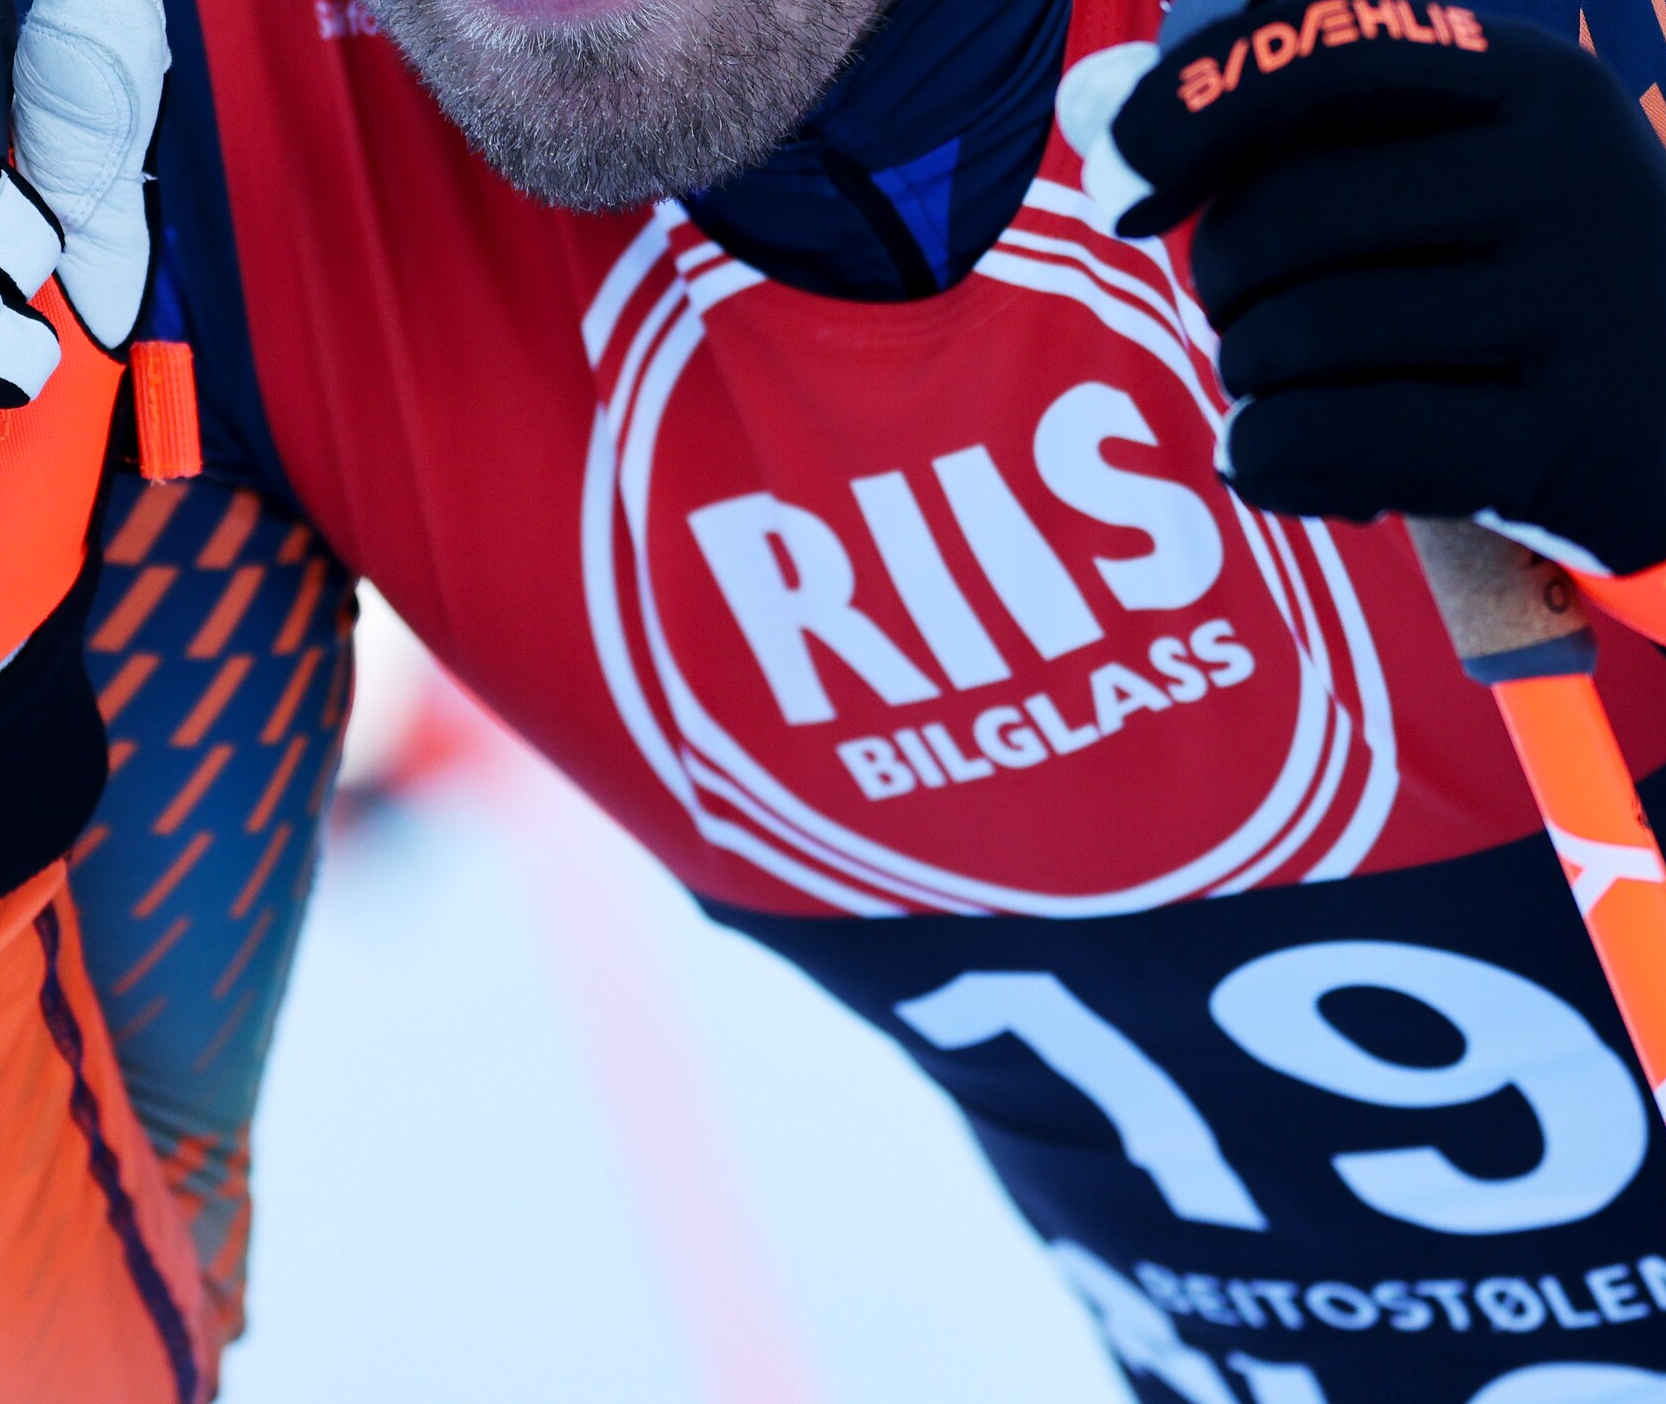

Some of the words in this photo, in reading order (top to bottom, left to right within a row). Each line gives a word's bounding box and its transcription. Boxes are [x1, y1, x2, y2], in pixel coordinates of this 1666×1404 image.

[686, 380, 1225, 726] RIIS
[836, 618, 1256, 801] BILGLASS
[895, 940, 1649, 1235] 19
